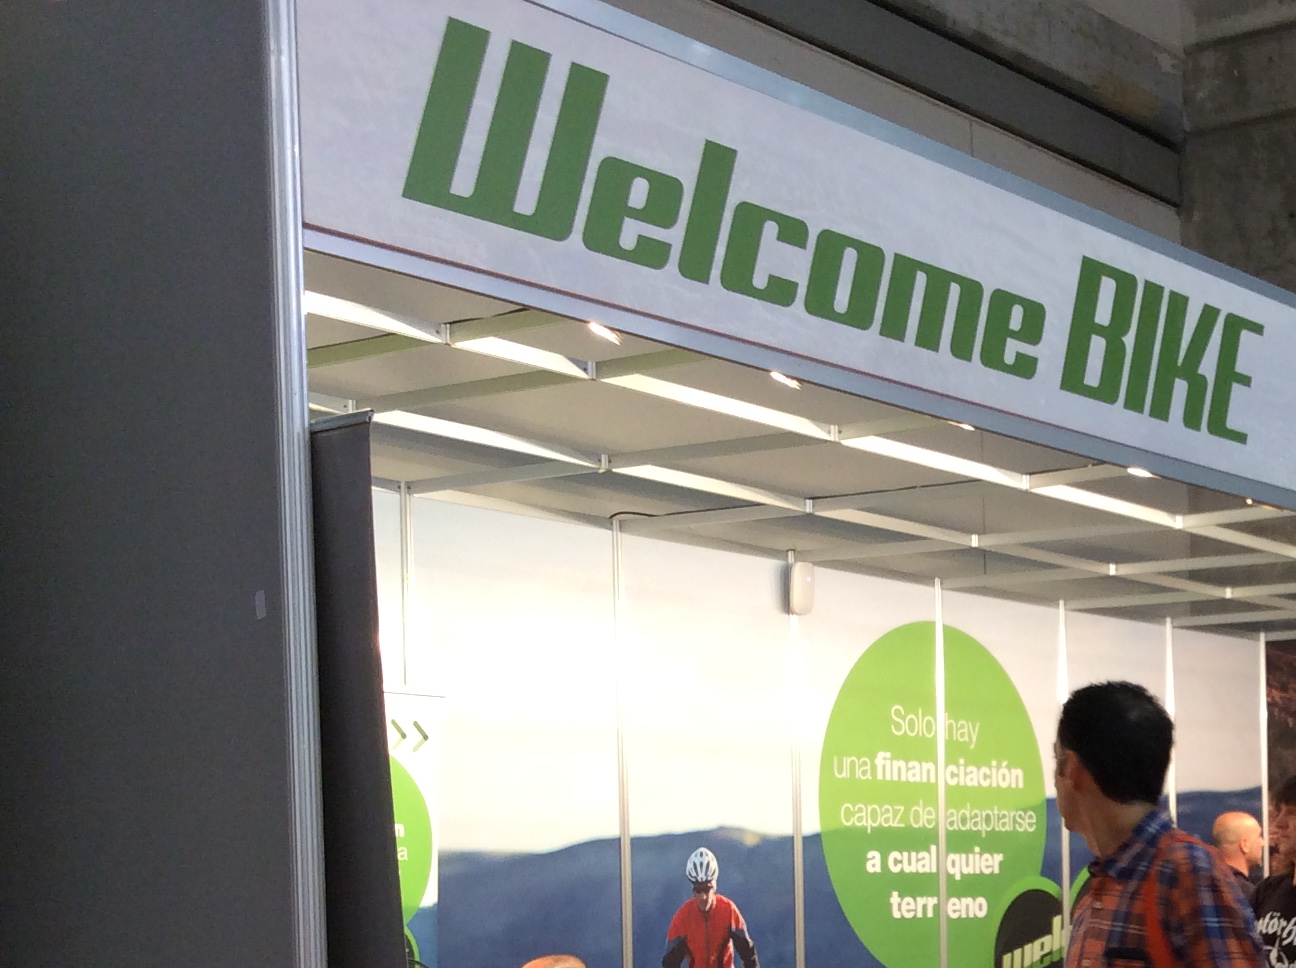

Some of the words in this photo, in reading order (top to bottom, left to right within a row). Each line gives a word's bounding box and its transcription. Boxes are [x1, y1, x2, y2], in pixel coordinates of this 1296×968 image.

[402, 17, 1046, 379] Welcome
[1060, 255, 1265, 445] BIKE
[890, 705, 936, 738] Solo
[945, 712, 980, 749] hay
[834, 755, 872, 780] una
[840, 802, 905, 834] capaz
[910, 800, 936, 829] de
[946, 802, 1037, 838] adaptarse
[866, 849, 882, 873] a
[888, 845, 1004, 880] cualquier
[890, 892, 988, 919] terreno
